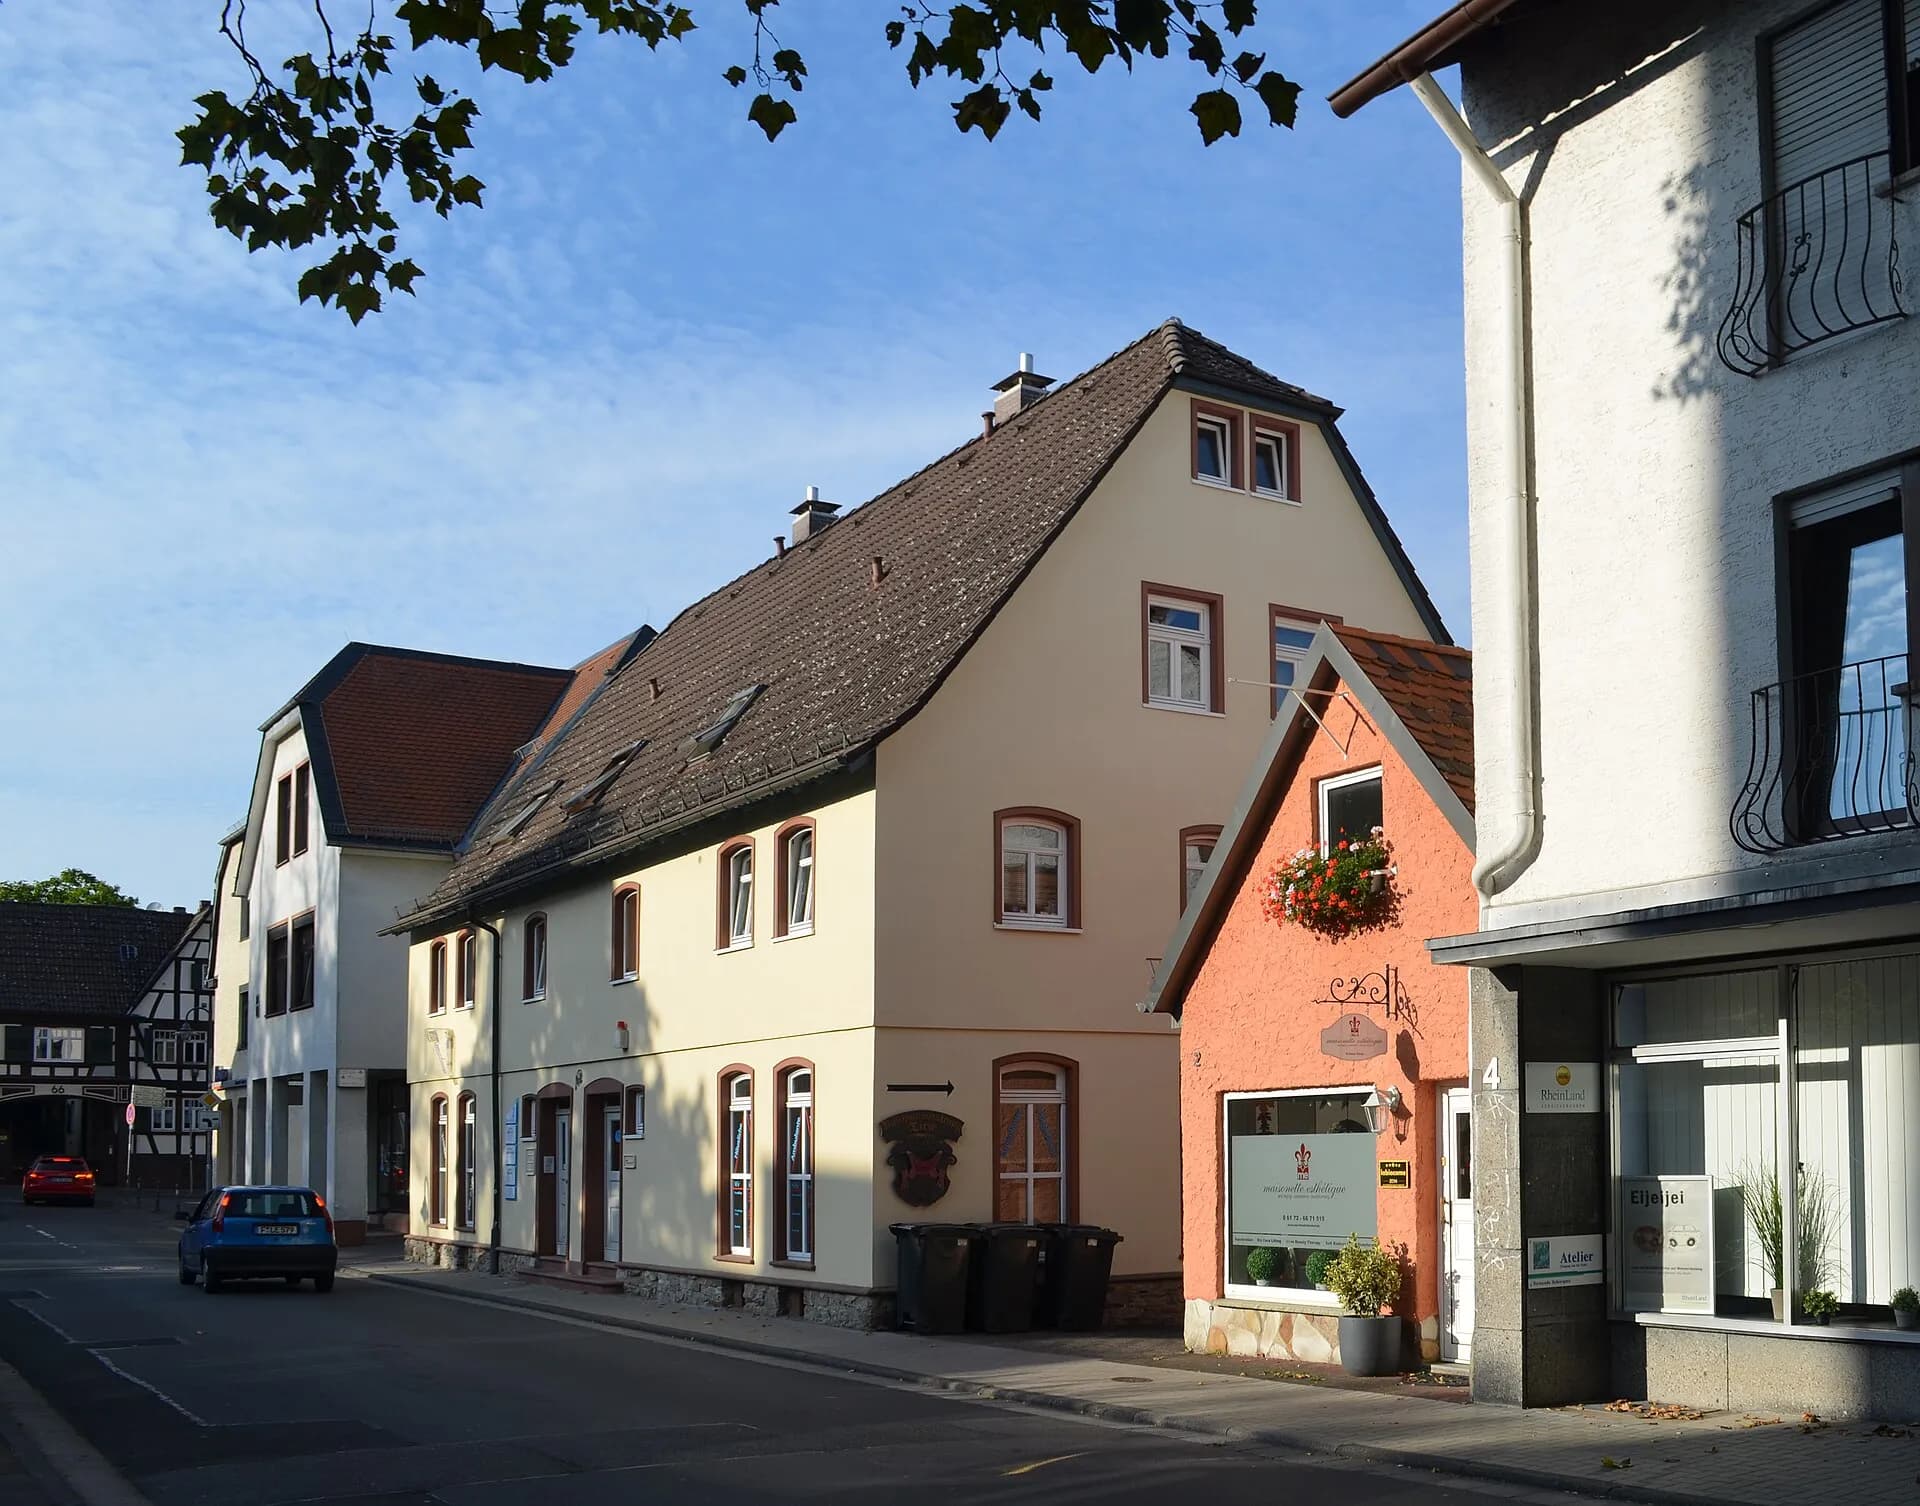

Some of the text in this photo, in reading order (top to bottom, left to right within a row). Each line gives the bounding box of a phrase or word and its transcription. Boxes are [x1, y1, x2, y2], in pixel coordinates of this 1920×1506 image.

[1482, 1057, 1500, 1090] 4
[51, 1085, 65, 1094] 66
[1541, 1089, 1585, 1101] RheinLand
[1560, 1251, 1594, 1264] Atelier
